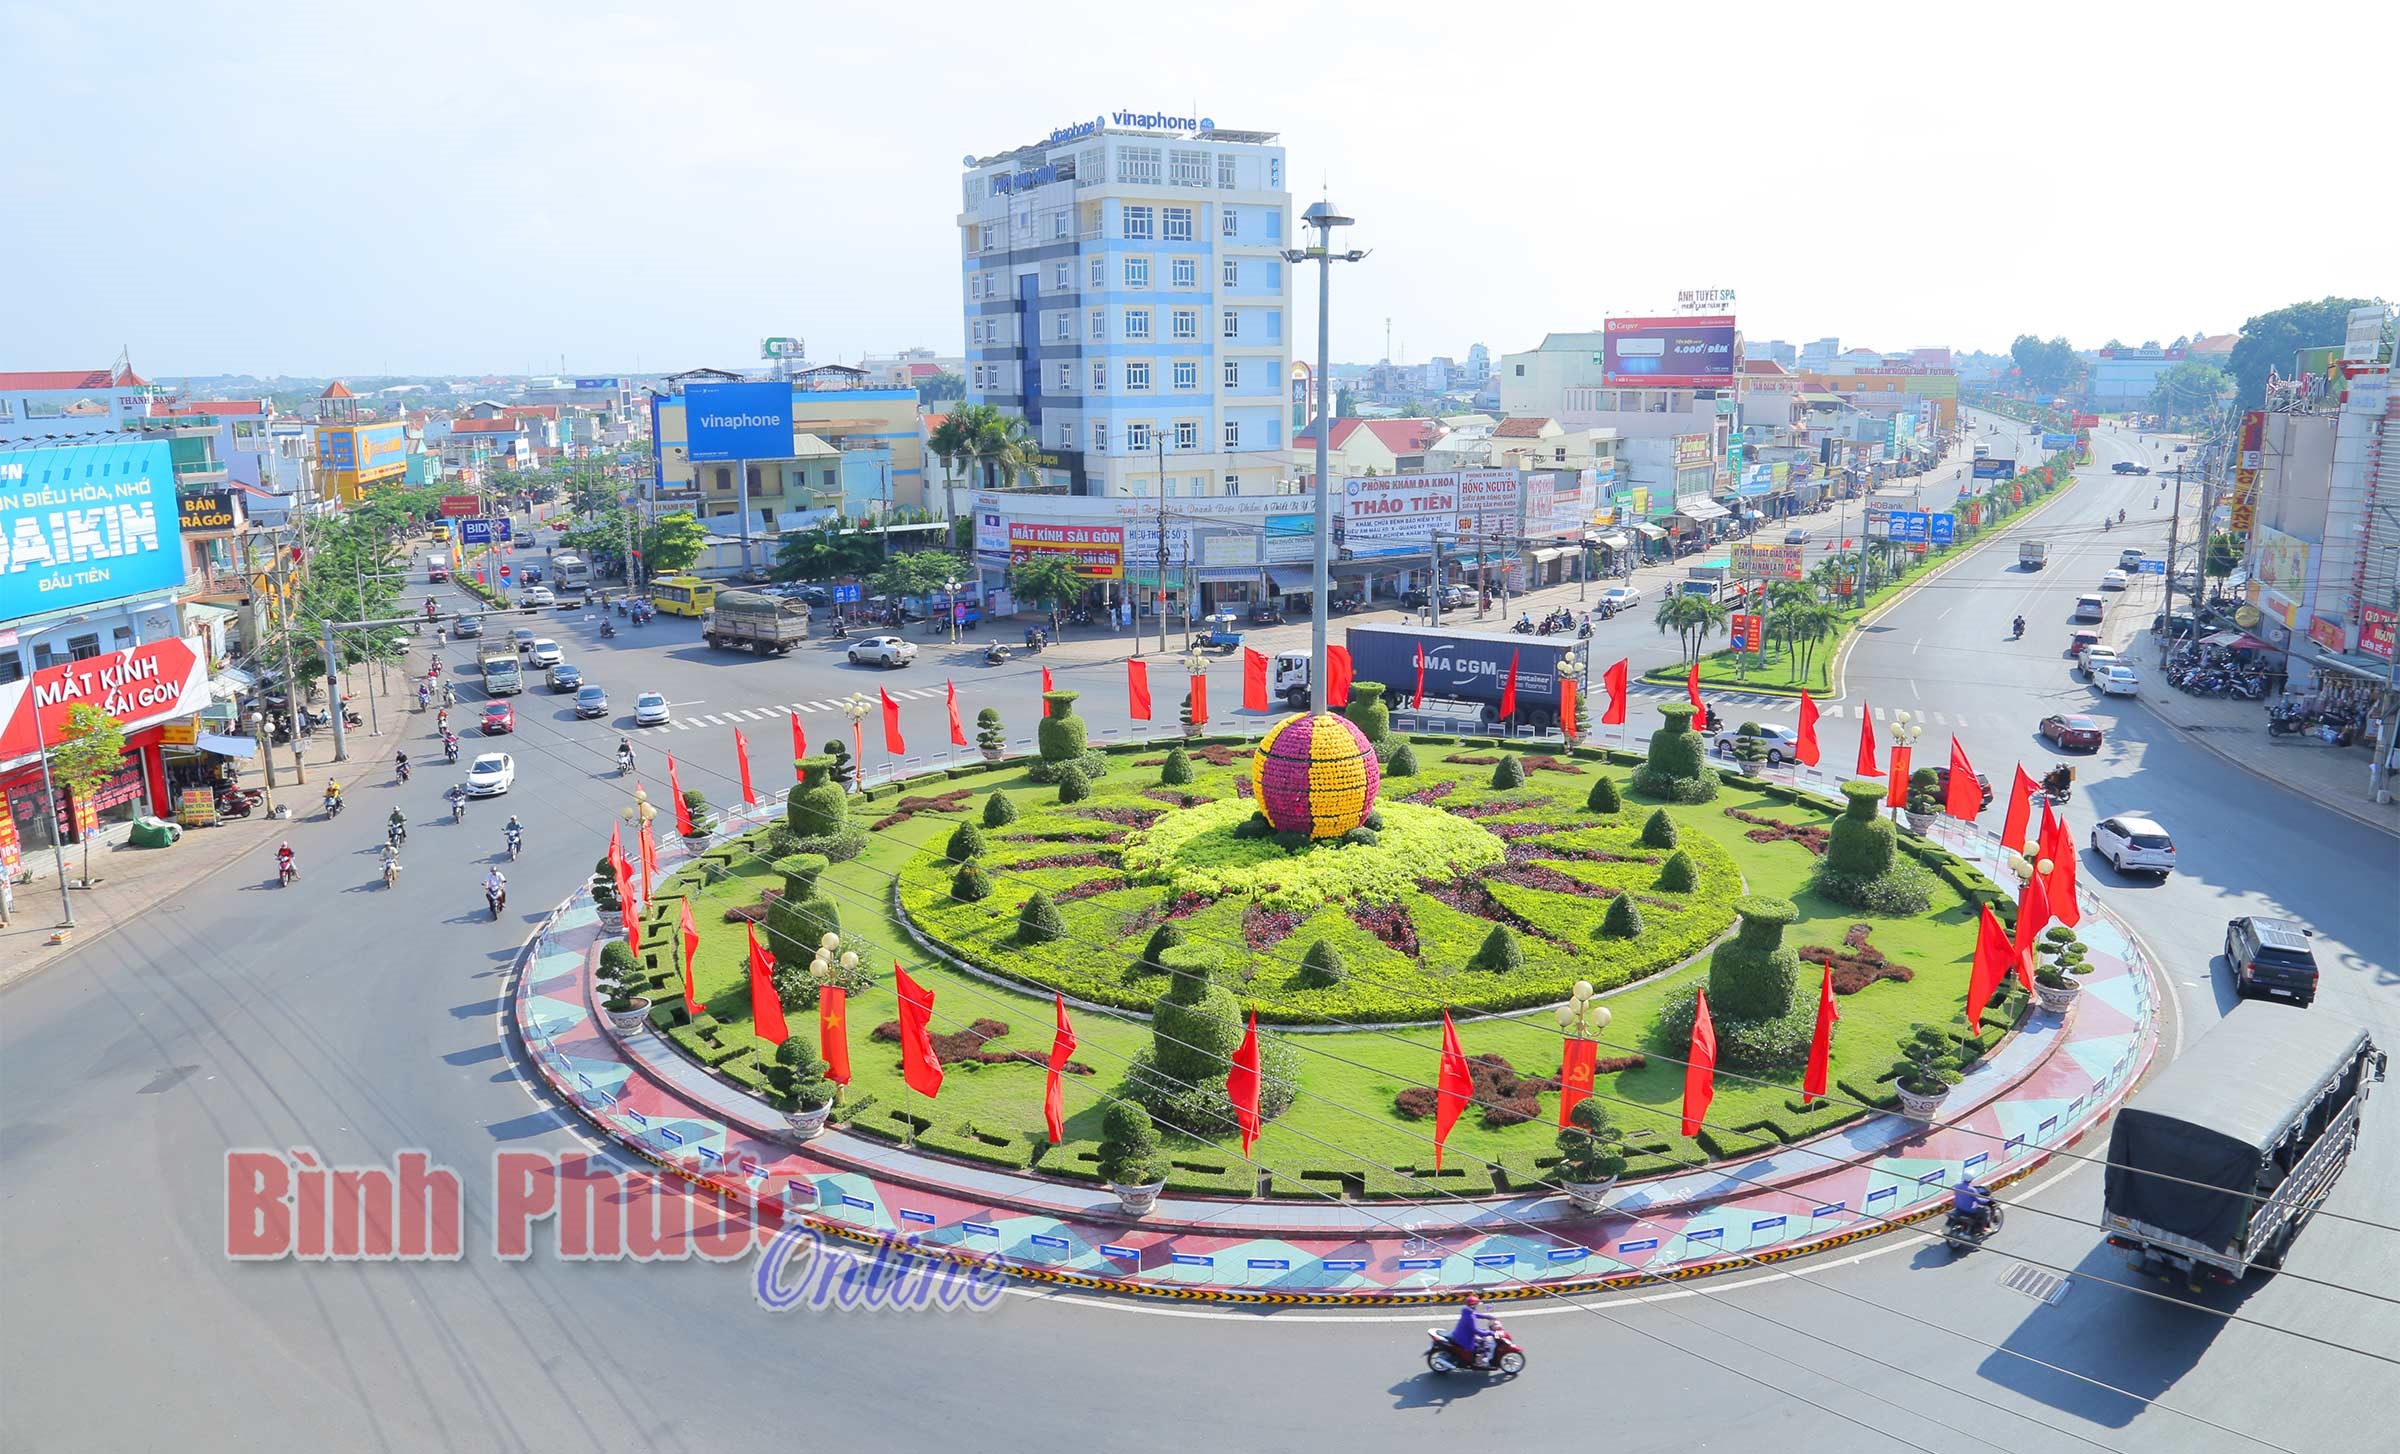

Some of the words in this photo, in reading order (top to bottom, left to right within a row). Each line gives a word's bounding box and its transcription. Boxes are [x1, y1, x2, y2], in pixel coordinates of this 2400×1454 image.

[1112, 109, 1196, 130] vinaphone
[1720, 289, 1735, 301] SPA
[701, 413, 780, 430] vinaphone
[23, 483, 67, 508] ĐIỀU
[70, 482, 113, 503] HÒA,
[115, 477, 152, 497] NHỚ
[1361, 479, 1390, 492] PHÒNG
[1393, 477, 1416, 489] KHÁM
[1418, 479, 1429, 488] ĐA
[1430, 477, 1454, 488] KHOA
[184, 497, 216, 511] BÁN
[1351, 494, 1403, 515] THẢO
[1410, 493, 1452, 512] TIÊN
[1870, 501, 1904, 510] HDBank
[202, 512, 232, 526] GÓP
[1012, 525, 1034, 540] MẮT
[1037, 527, 1063, 541] KÍNH
[1067, 528, 1089, 542] SÀI
[1092, 529, 1120, 543] GÒN
[1183, 530, 1188, 539] 3
[38, 570, 73, 592] ĐẦU
[74, 566, 111, 585] TIÊN
[1456, 659, 1496, 676] CGM
[36, 665, 94, 709] MẮT
[100, 655, 159, 691] KÍNH
[103, 689, 136, 718] SÀI
[139, 678, 181, 704] GÒN
